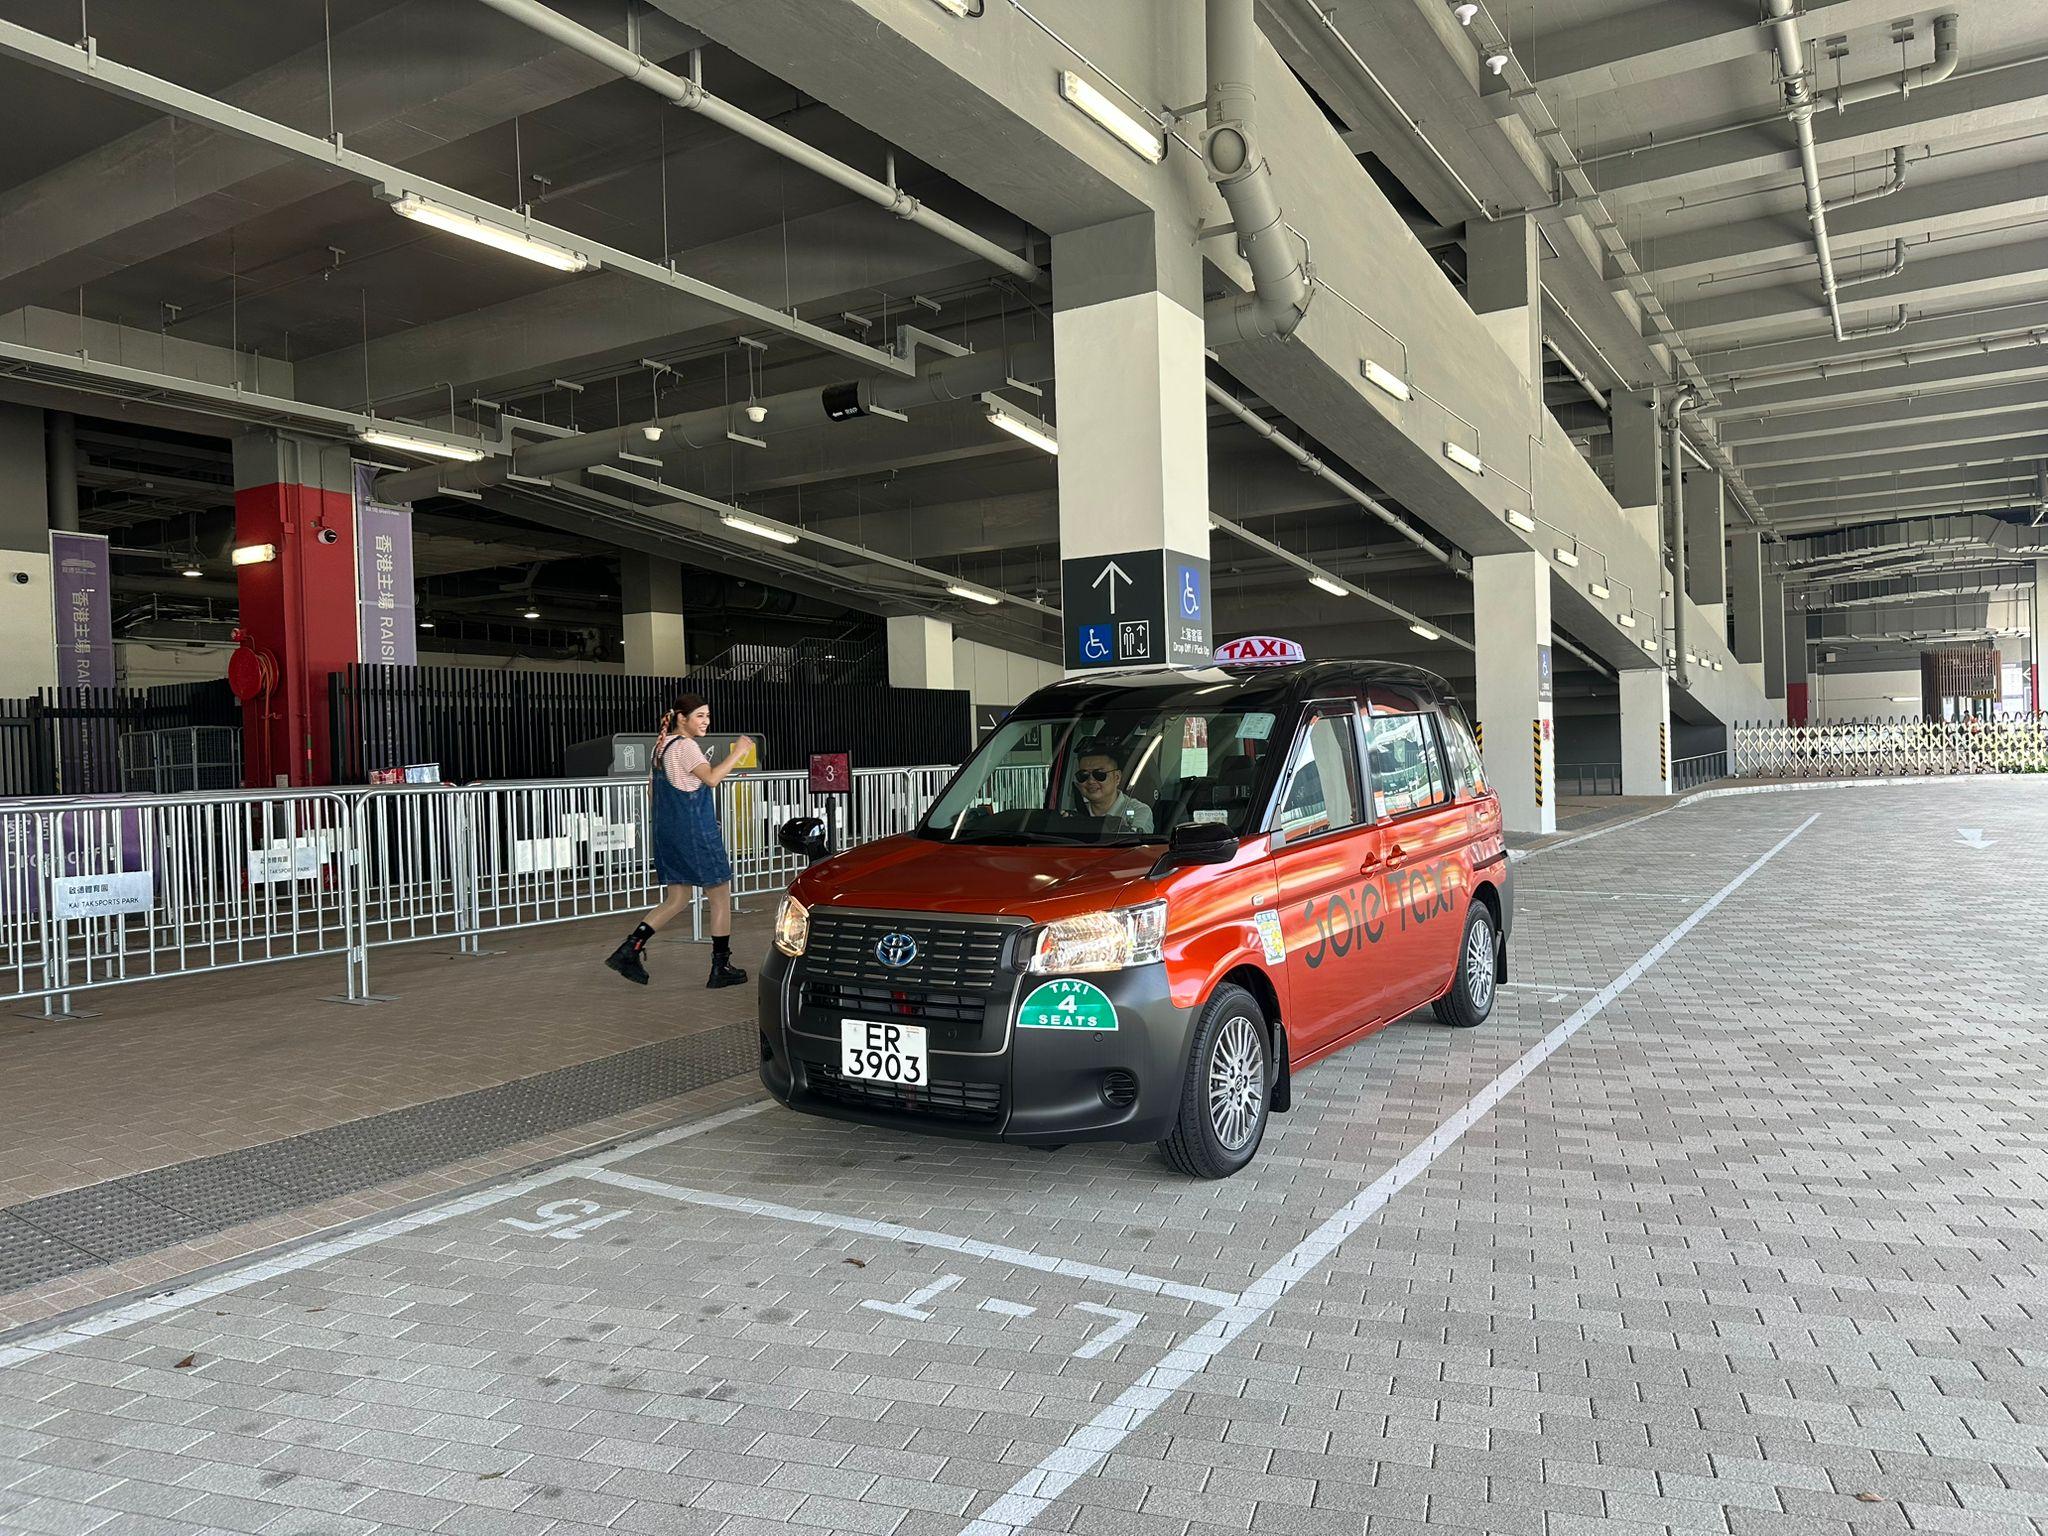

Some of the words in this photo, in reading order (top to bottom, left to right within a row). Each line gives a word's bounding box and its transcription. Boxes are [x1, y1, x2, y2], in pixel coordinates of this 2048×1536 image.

[375, 534, 394, 609] 香港主場
[72, 591, 91, 654] 香港主場
[1223, 639, 1287, 659] TAXI
[826, 765, 834, 782] 3
[82, 900, 94, 908] TAK
[95, 898, 120, 907] SPORTS
[1387, 860, 1455, 931] Taxi
[1049, 982, 1090, 995] TAXI
[1057, 994, 1078, 1014] 4
[1038, 1014, 1098, 1027] SEATS
[866, 1022, 901, 1053] ER
[848, 1048, 921, 1083] 3903
